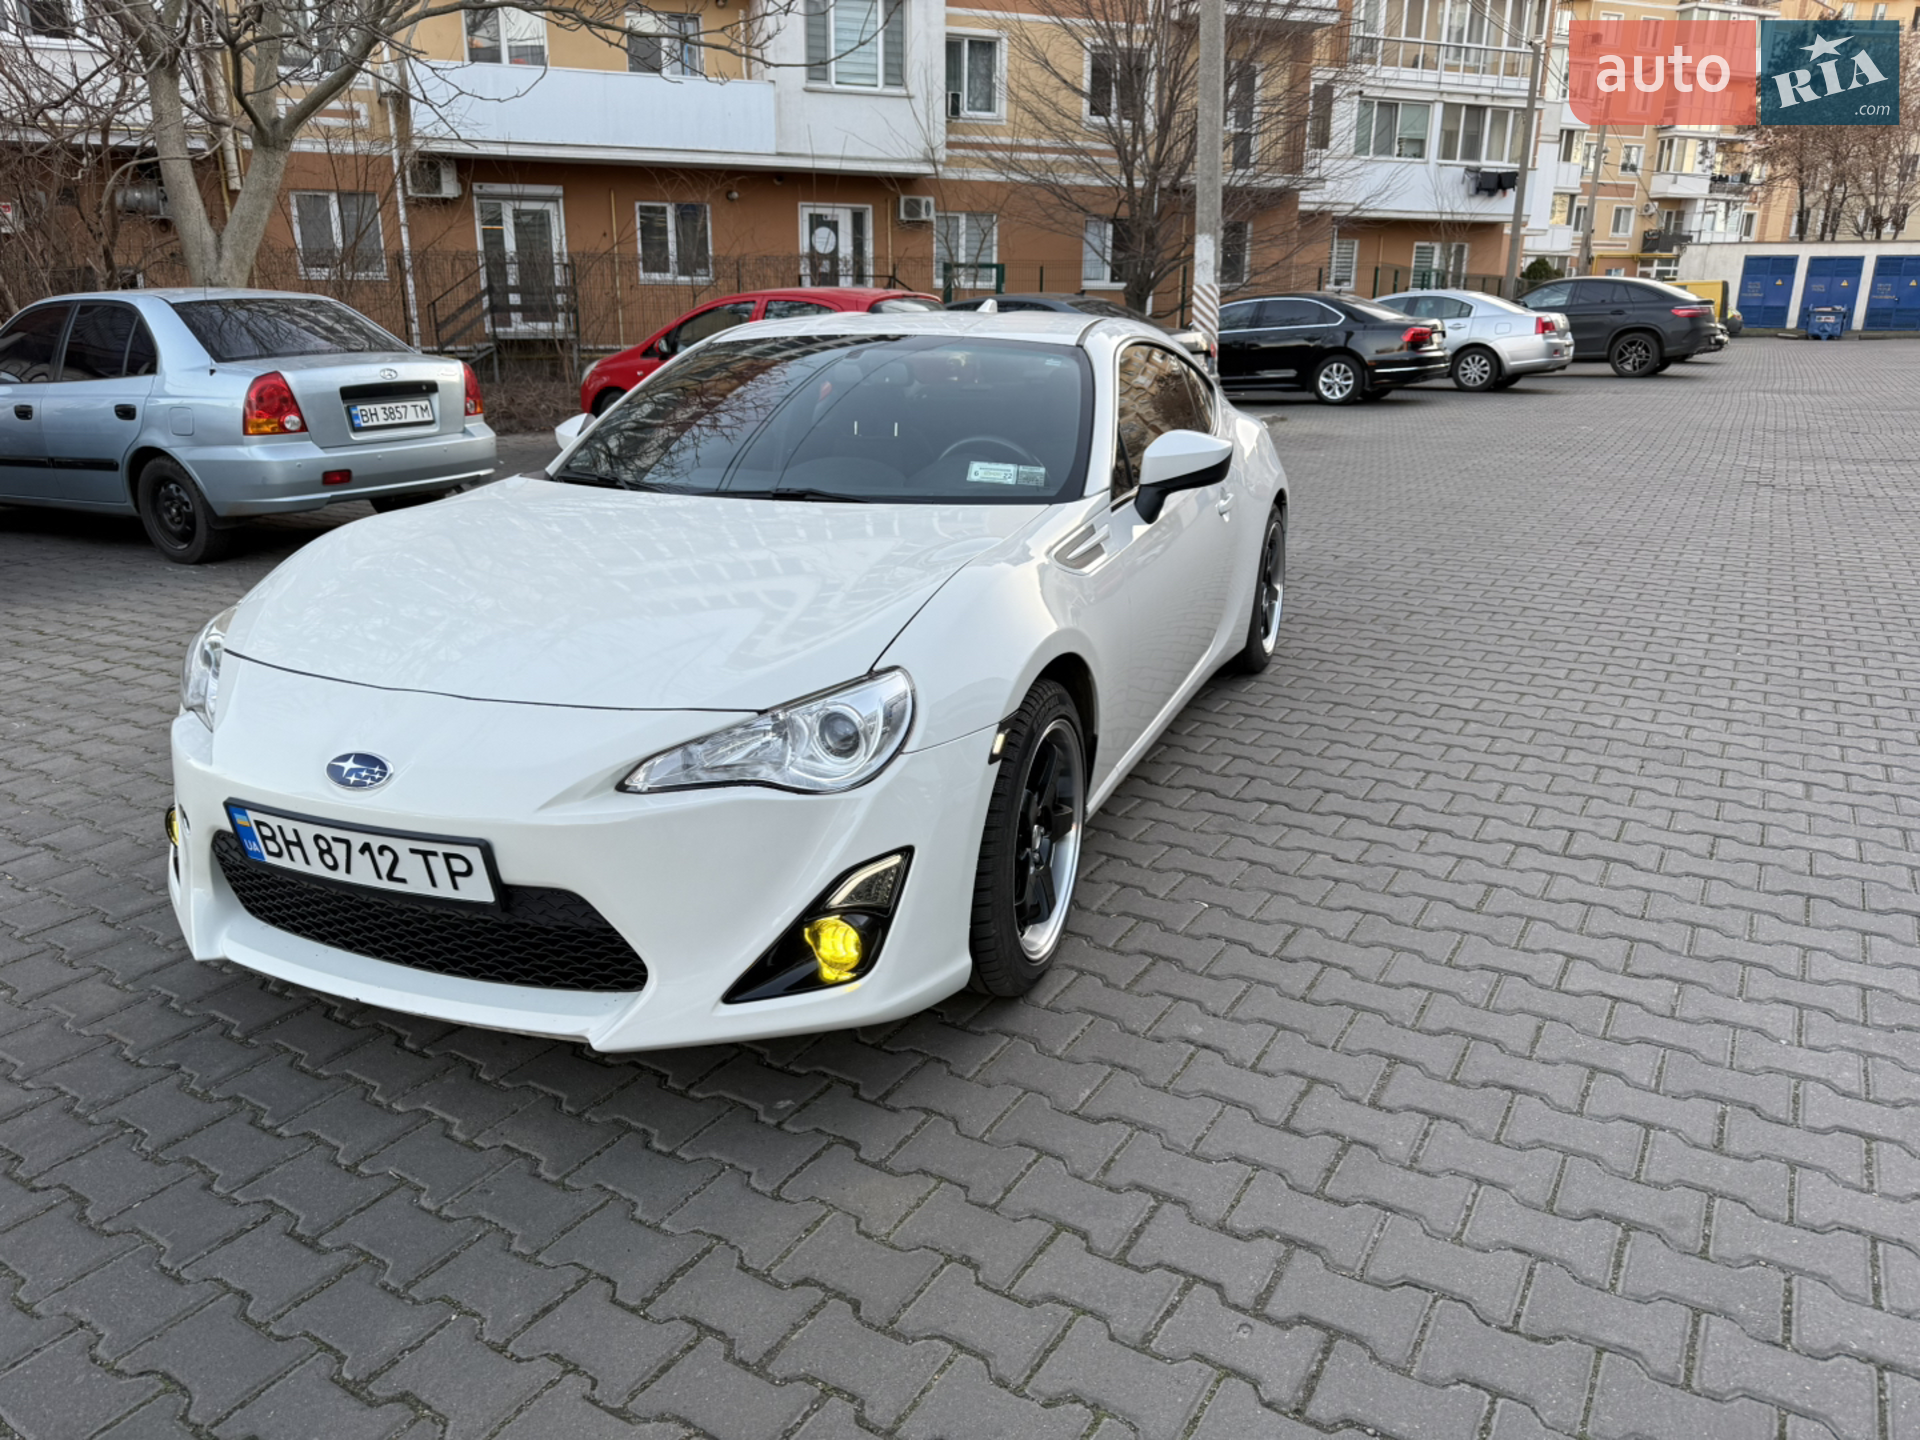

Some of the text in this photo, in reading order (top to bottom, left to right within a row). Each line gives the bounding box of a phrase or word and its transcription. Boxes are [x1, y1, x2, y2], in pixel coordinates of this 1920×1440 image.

[360, 404, 431, 423] BH 3857 TM
[243, 838, 261, 853] UA
[253, 819, 474, 891] BH 8712 TP
